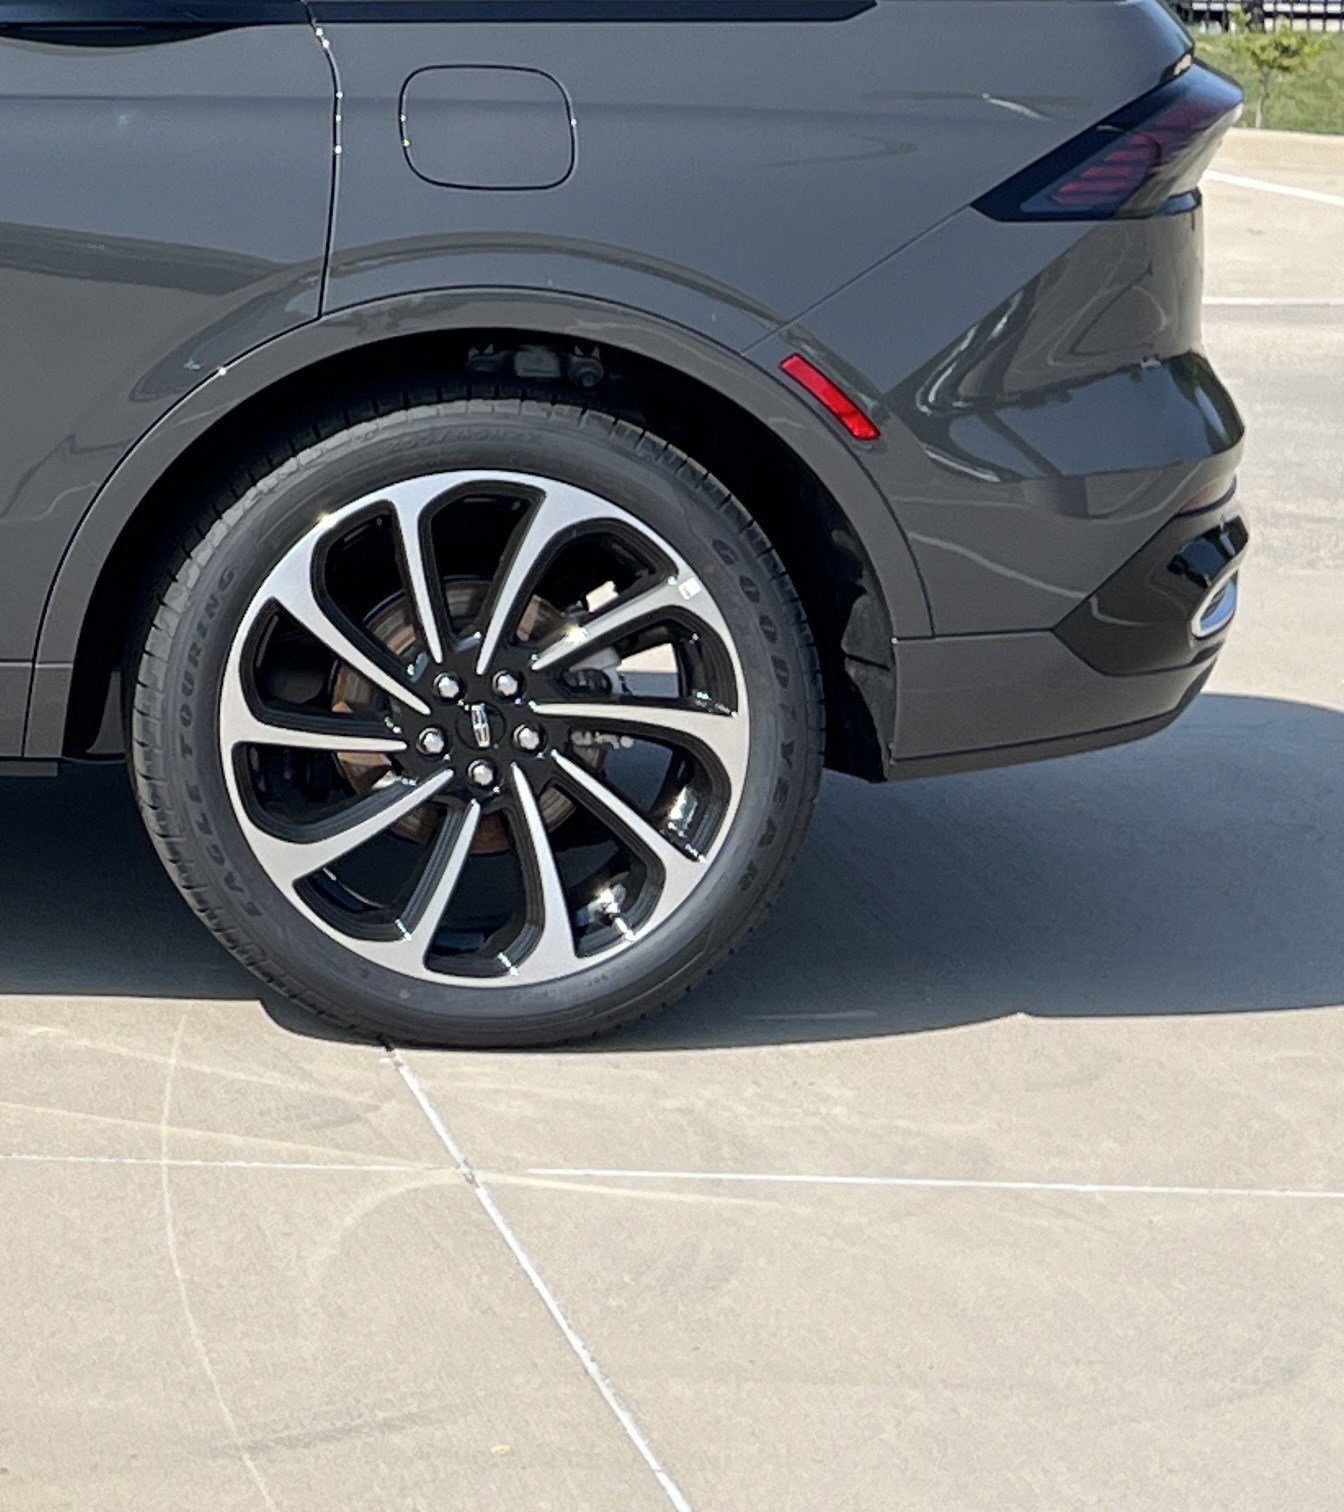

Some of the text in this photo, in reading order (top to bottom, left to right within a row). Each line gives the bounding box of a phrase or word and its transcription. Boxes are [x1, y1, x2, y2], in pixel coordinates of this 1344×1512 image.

[178, 564, 264, 918] EAGLE TOURING
[710, 536, 797, 894] GOODYEAR
